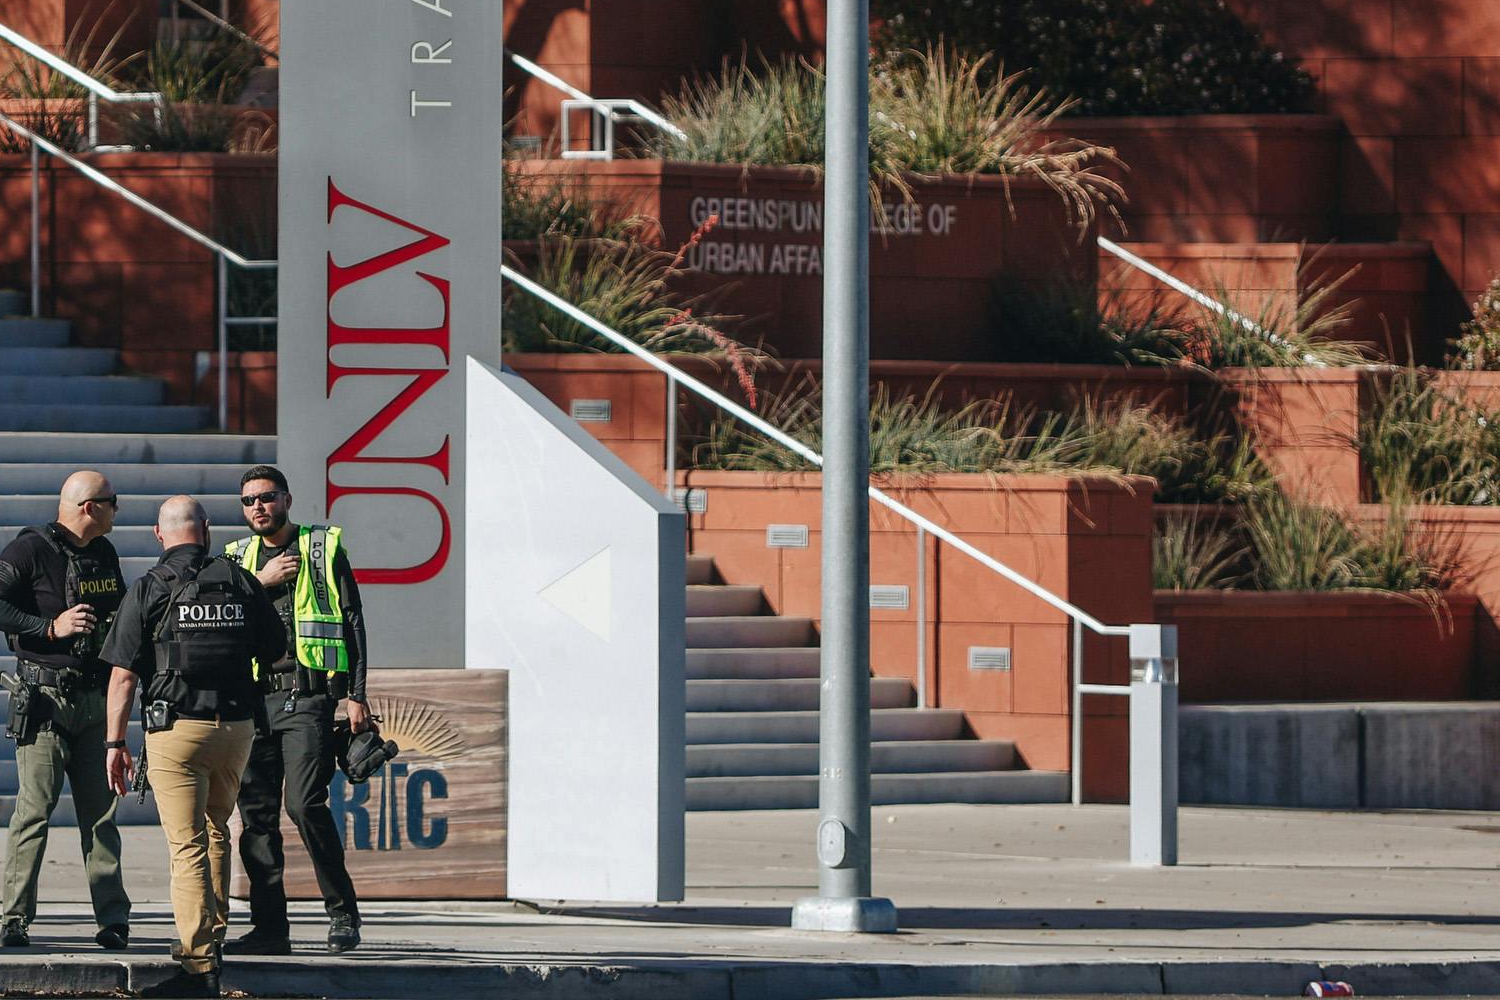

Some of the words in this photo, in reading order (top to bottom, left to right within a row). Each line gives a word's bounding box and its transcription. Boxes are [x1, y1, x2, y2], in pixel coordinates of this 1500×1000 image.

[927, 202, 957, 235] OF
[690, 242, 764, 273] URBAN
[769, 245, 822, 274] AFFA
[326, 175, 451, 585] UNLV
[80, 578, 118, 595] POLICE
[312, 541, 325, 600] POLICE
[178, 604, 245, 621] POLICE
[330, 764, 449, 850] RTC
